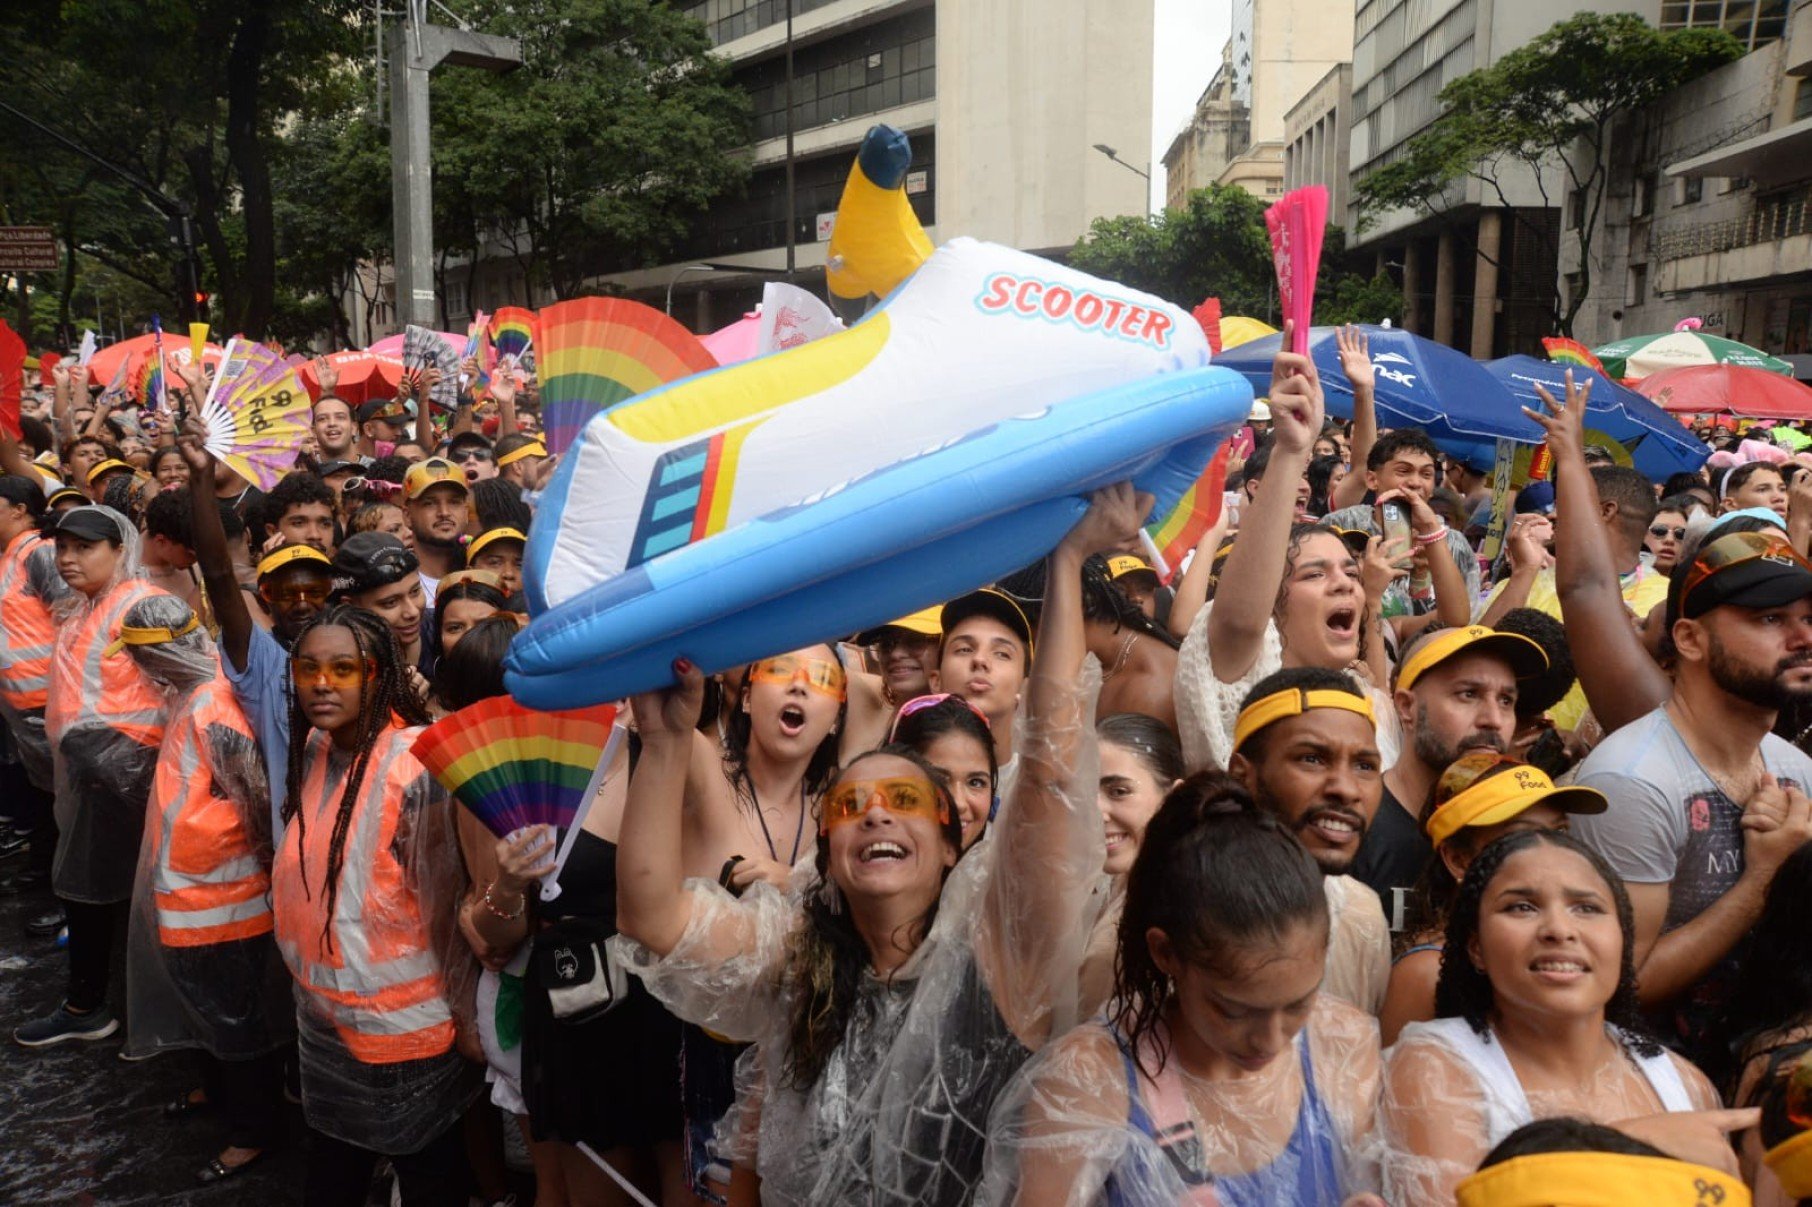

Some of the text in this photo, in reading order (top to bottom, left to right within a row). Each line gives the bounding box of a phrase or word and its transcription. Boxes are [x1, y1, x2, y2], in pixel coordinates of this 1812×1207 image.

[980, 275, 1173, 347] SCOOTER
[271, 390, 292, 408] 99
[1514, 770, 1530, 781] 99
[1693, 1177, 1727, 1206] 99
